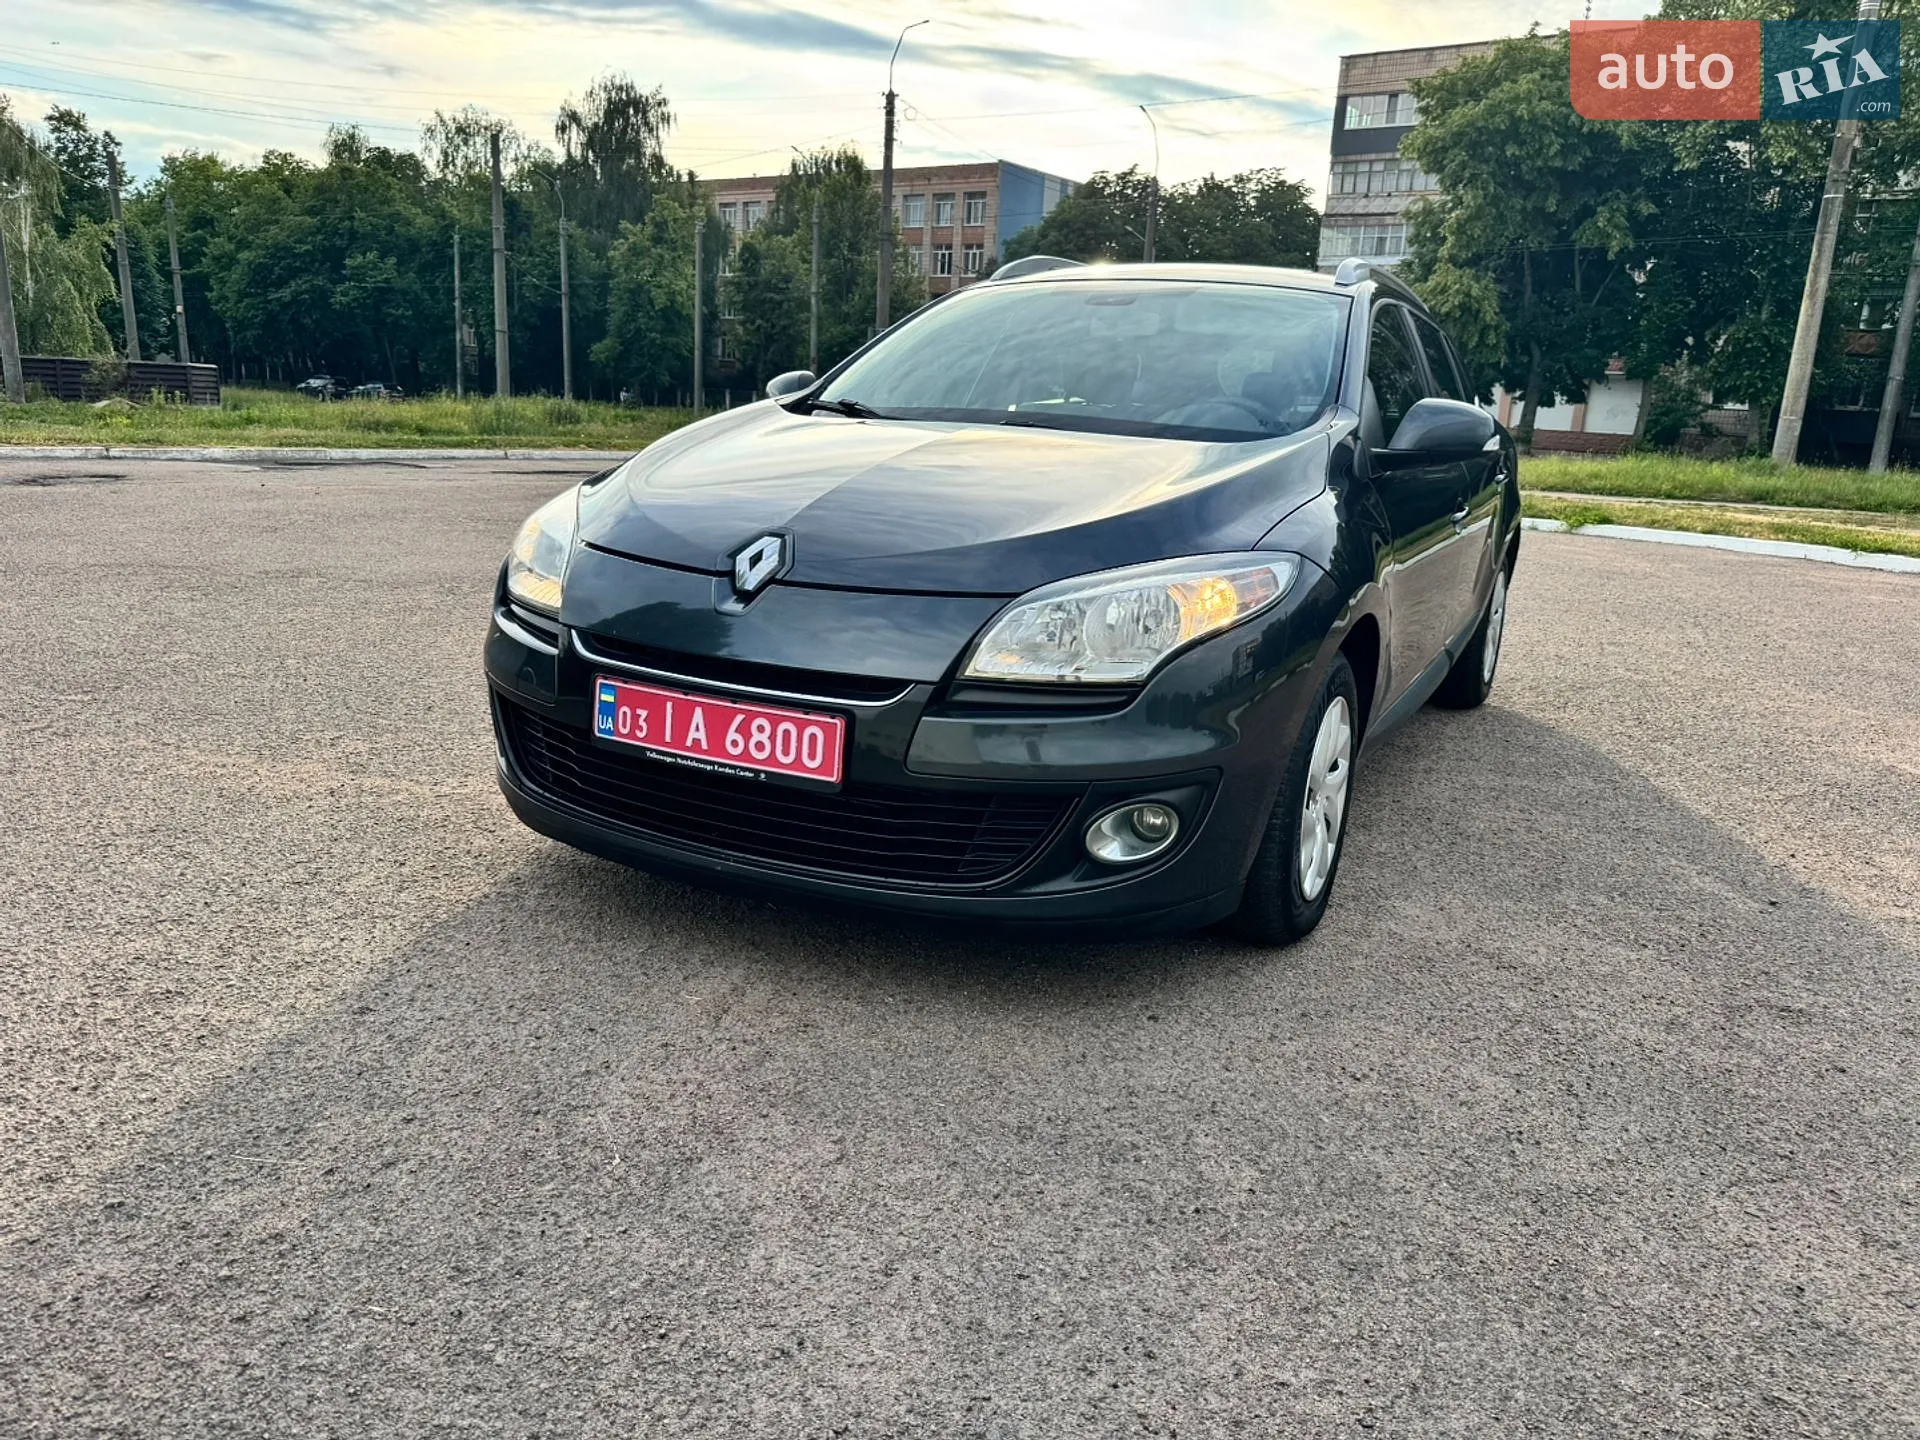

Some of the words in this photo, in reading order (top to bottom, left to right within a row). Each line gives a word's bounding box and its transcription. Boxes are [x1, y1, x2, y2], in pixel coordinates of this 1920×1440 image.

[598, 714, 614, 732] UA
[618, 705, 649, 739] 03
[725, 713, 825, 769] 6800
